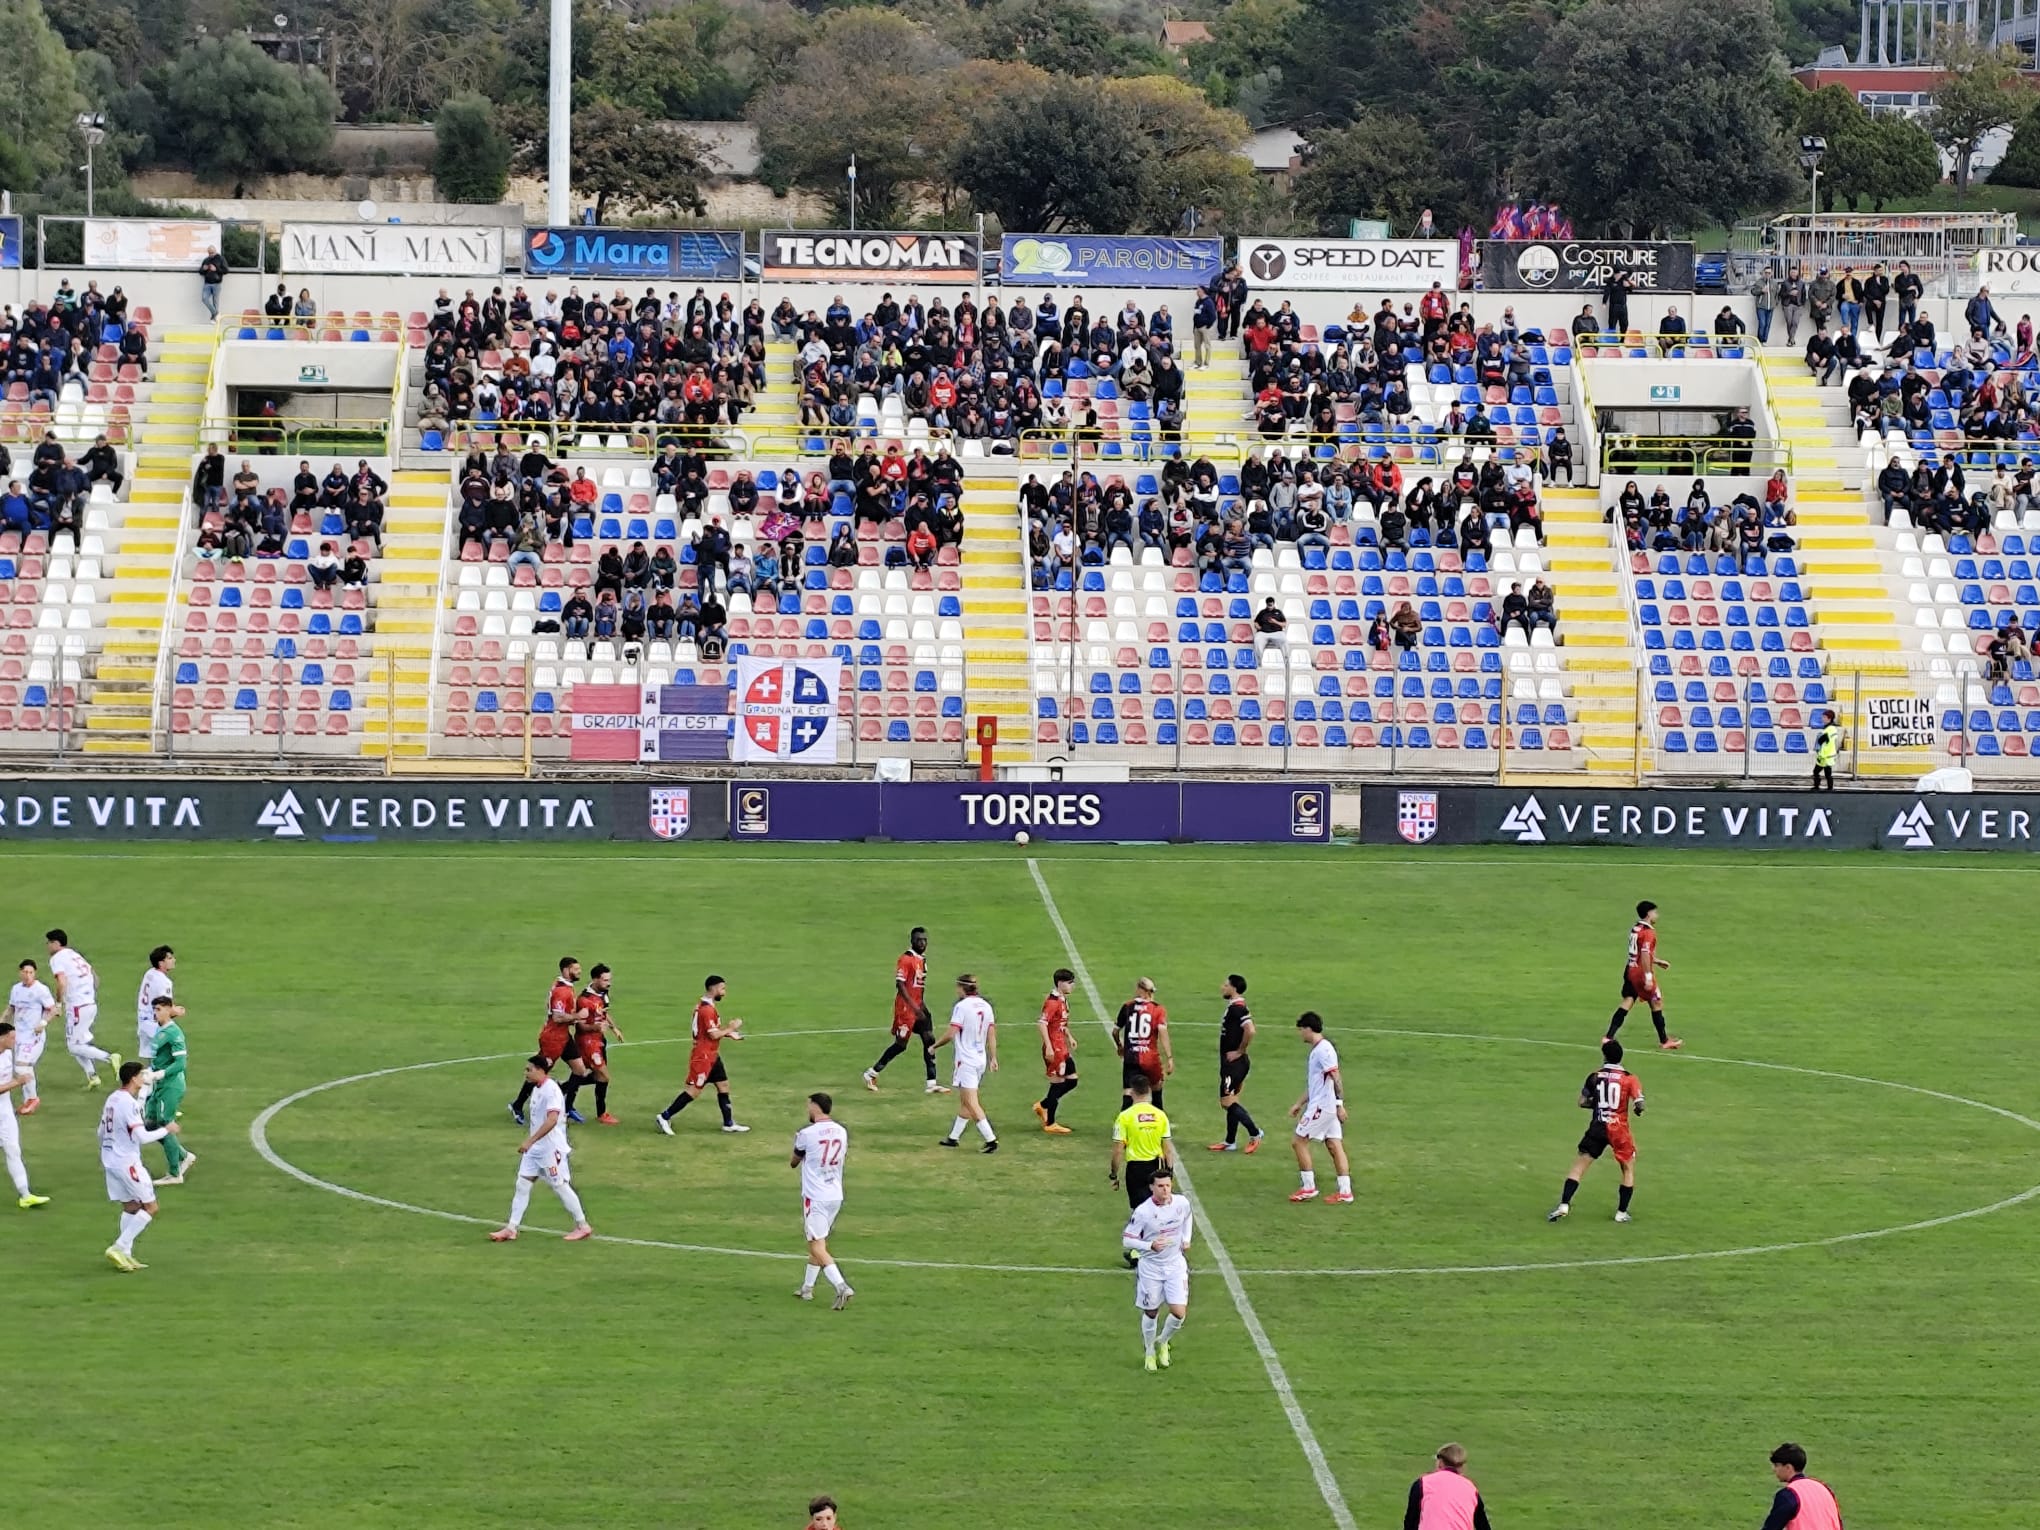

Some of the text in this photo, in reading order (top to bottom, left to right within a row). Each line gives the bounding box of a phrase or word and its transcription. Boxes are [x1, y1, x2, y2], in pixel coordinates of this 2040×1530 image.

[575, 236, 670, 265] Mara
[776, 236, 965, 267] TECNOMAT
[1078, 247, 1212, 271] PARQUET
[1293, 248, 1445, 268] SPEED DATE
[1293, 272, 1443, 283] COFFEE RESTAURANT PIZZA
[1569, 266, 1658, 288] per ABARE
[583, 715, 718, 729] GRADINATA EST
[745, 704, 828, 715] GRADINATA EST
[316, 798, 466, 828] VERDE
[960, 793, 1101, 826] TORRES
[1558, 804, 1706, 835] VERDE
[1946, 809, 2031, 839] VER
[1128, 1012, 1152, 1039] 16
[1597, 1080, 1621, 1111] 10
[818, 1139, 842, 1167] 72
